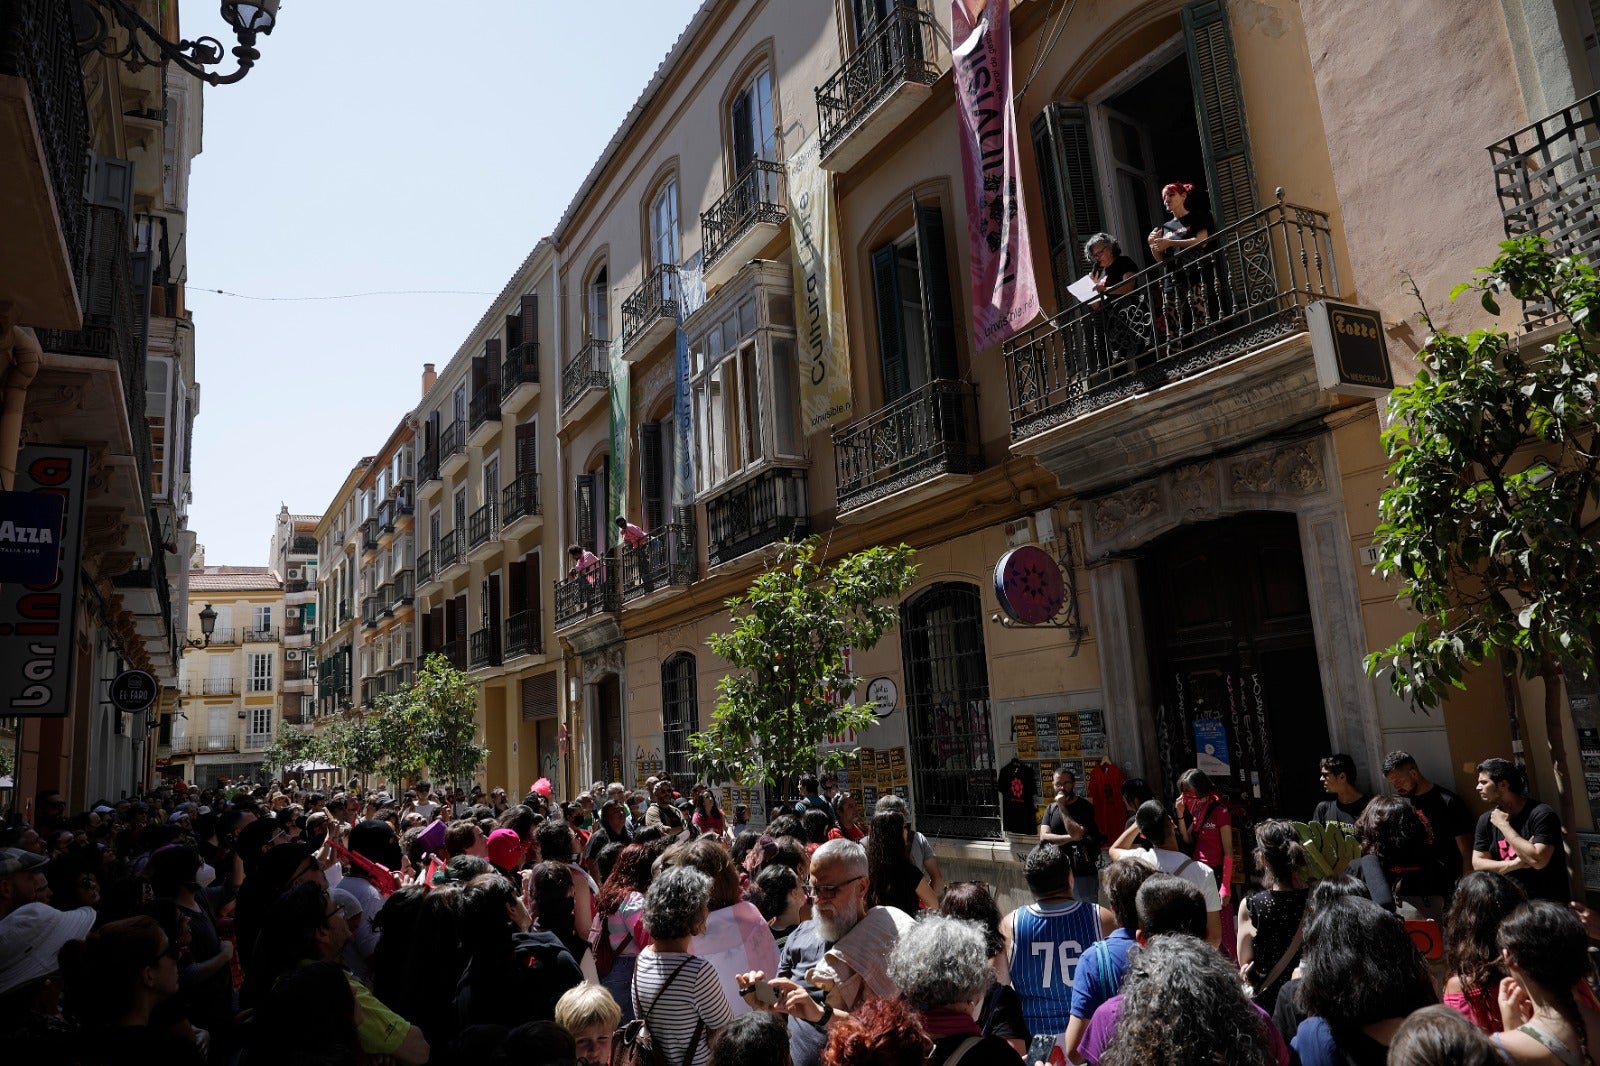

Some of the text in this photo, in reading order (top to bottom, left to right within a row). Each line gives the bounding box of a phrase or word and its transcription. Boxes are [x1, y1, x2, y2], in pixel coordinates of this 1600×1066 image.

[796, 190, 814, 268] Libre
[804, 273, 826, 386] Cultura
[10, 642, 57, 708] bar
[119, 689, 148, 700] EL FARO
[1031, 941, 1083, 988] 76
